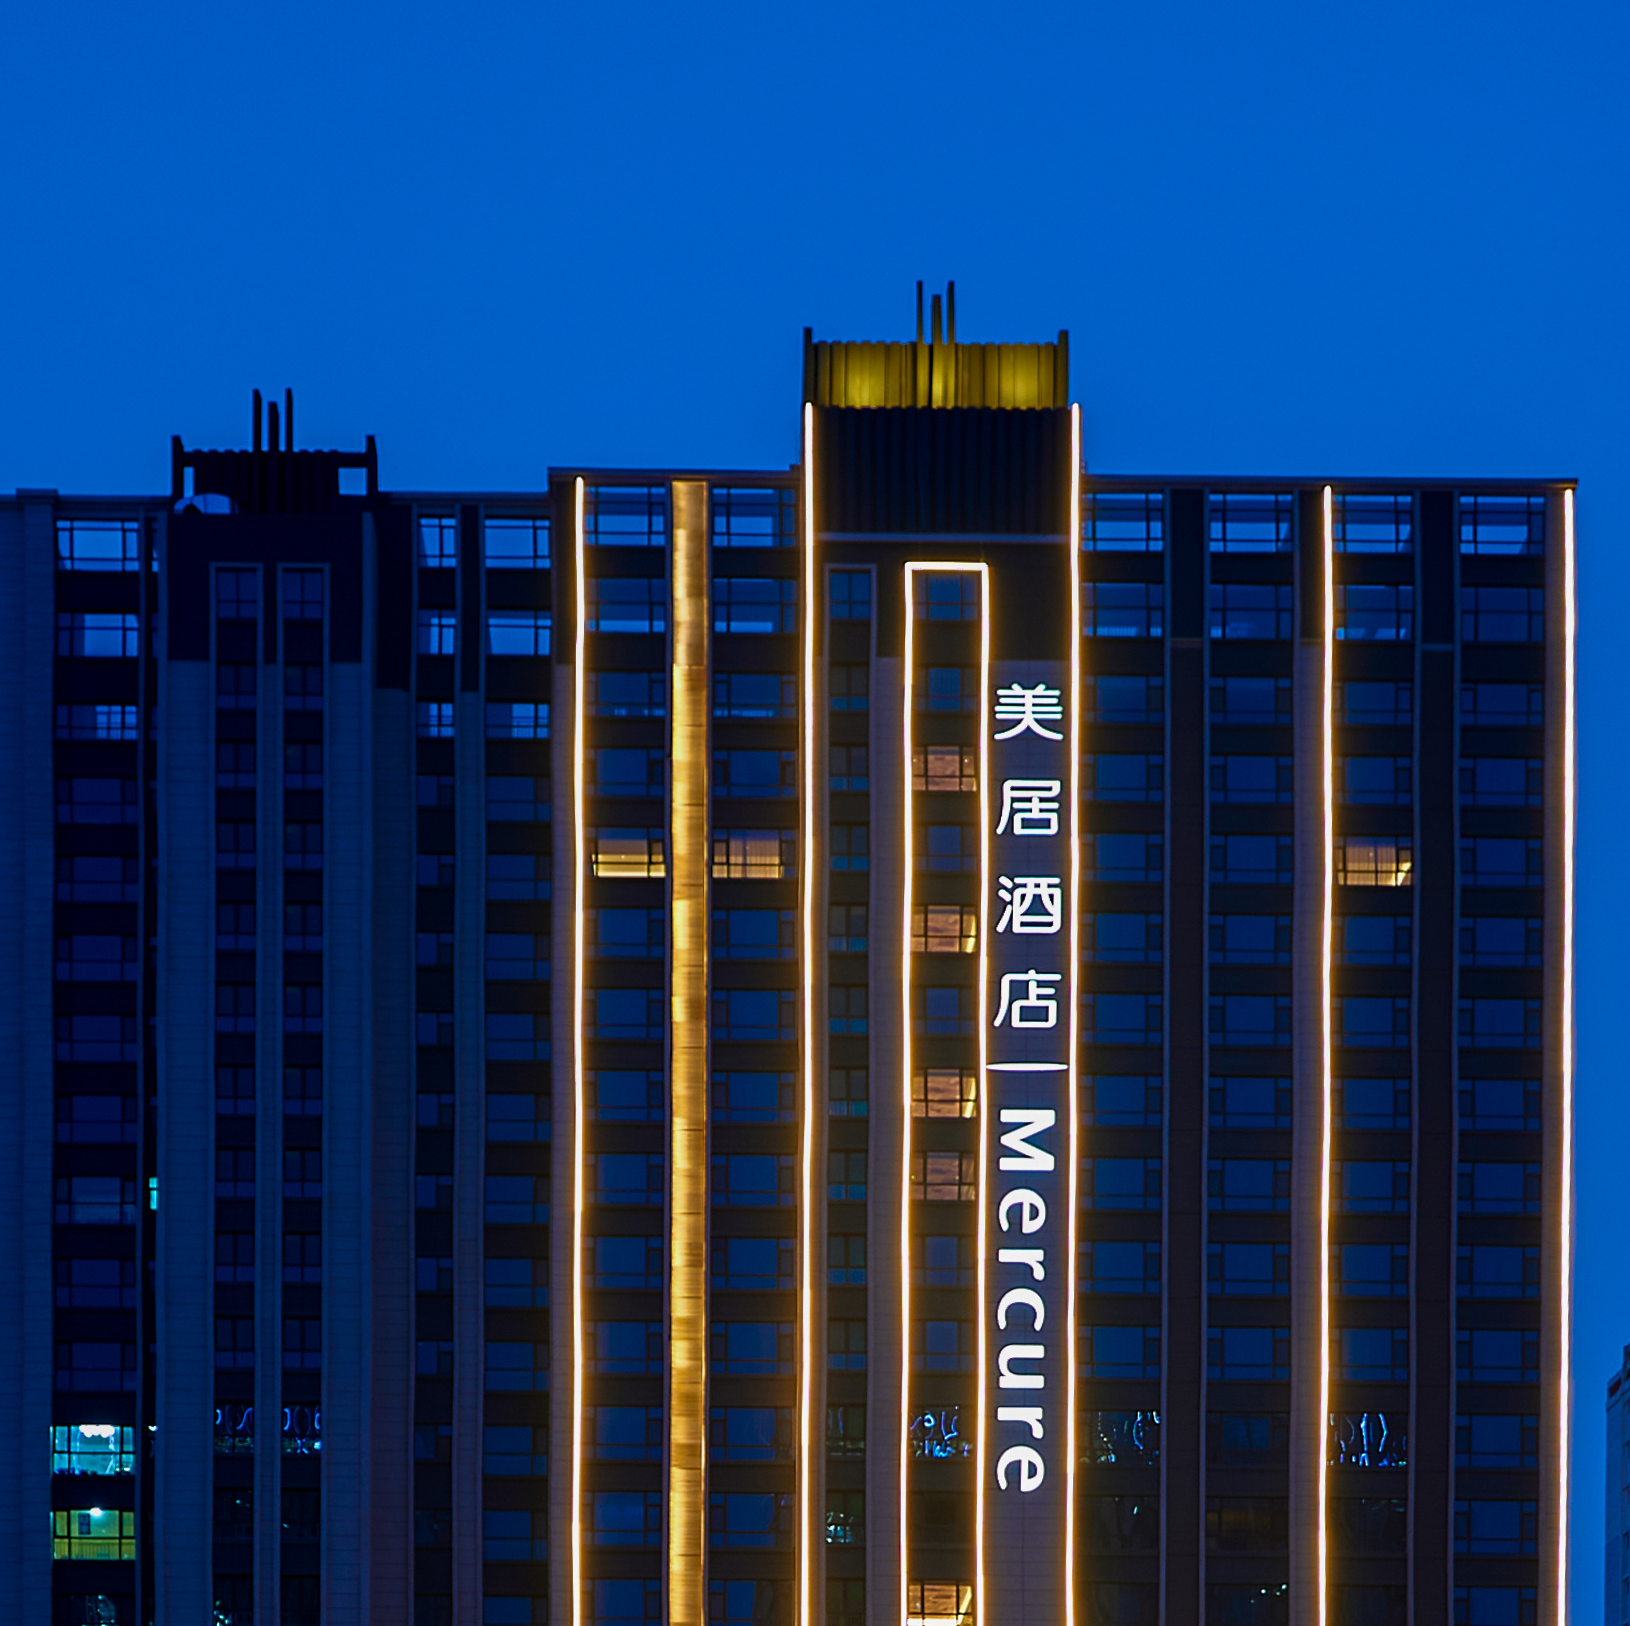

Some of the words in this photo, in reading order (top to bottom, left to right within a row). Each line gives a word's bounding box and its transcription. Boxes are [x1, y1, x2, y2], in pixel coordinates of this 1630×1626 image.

[993, 683, 1063, 1029] 美居酒店
[996, 1109, 1056, 1492] Mercure
